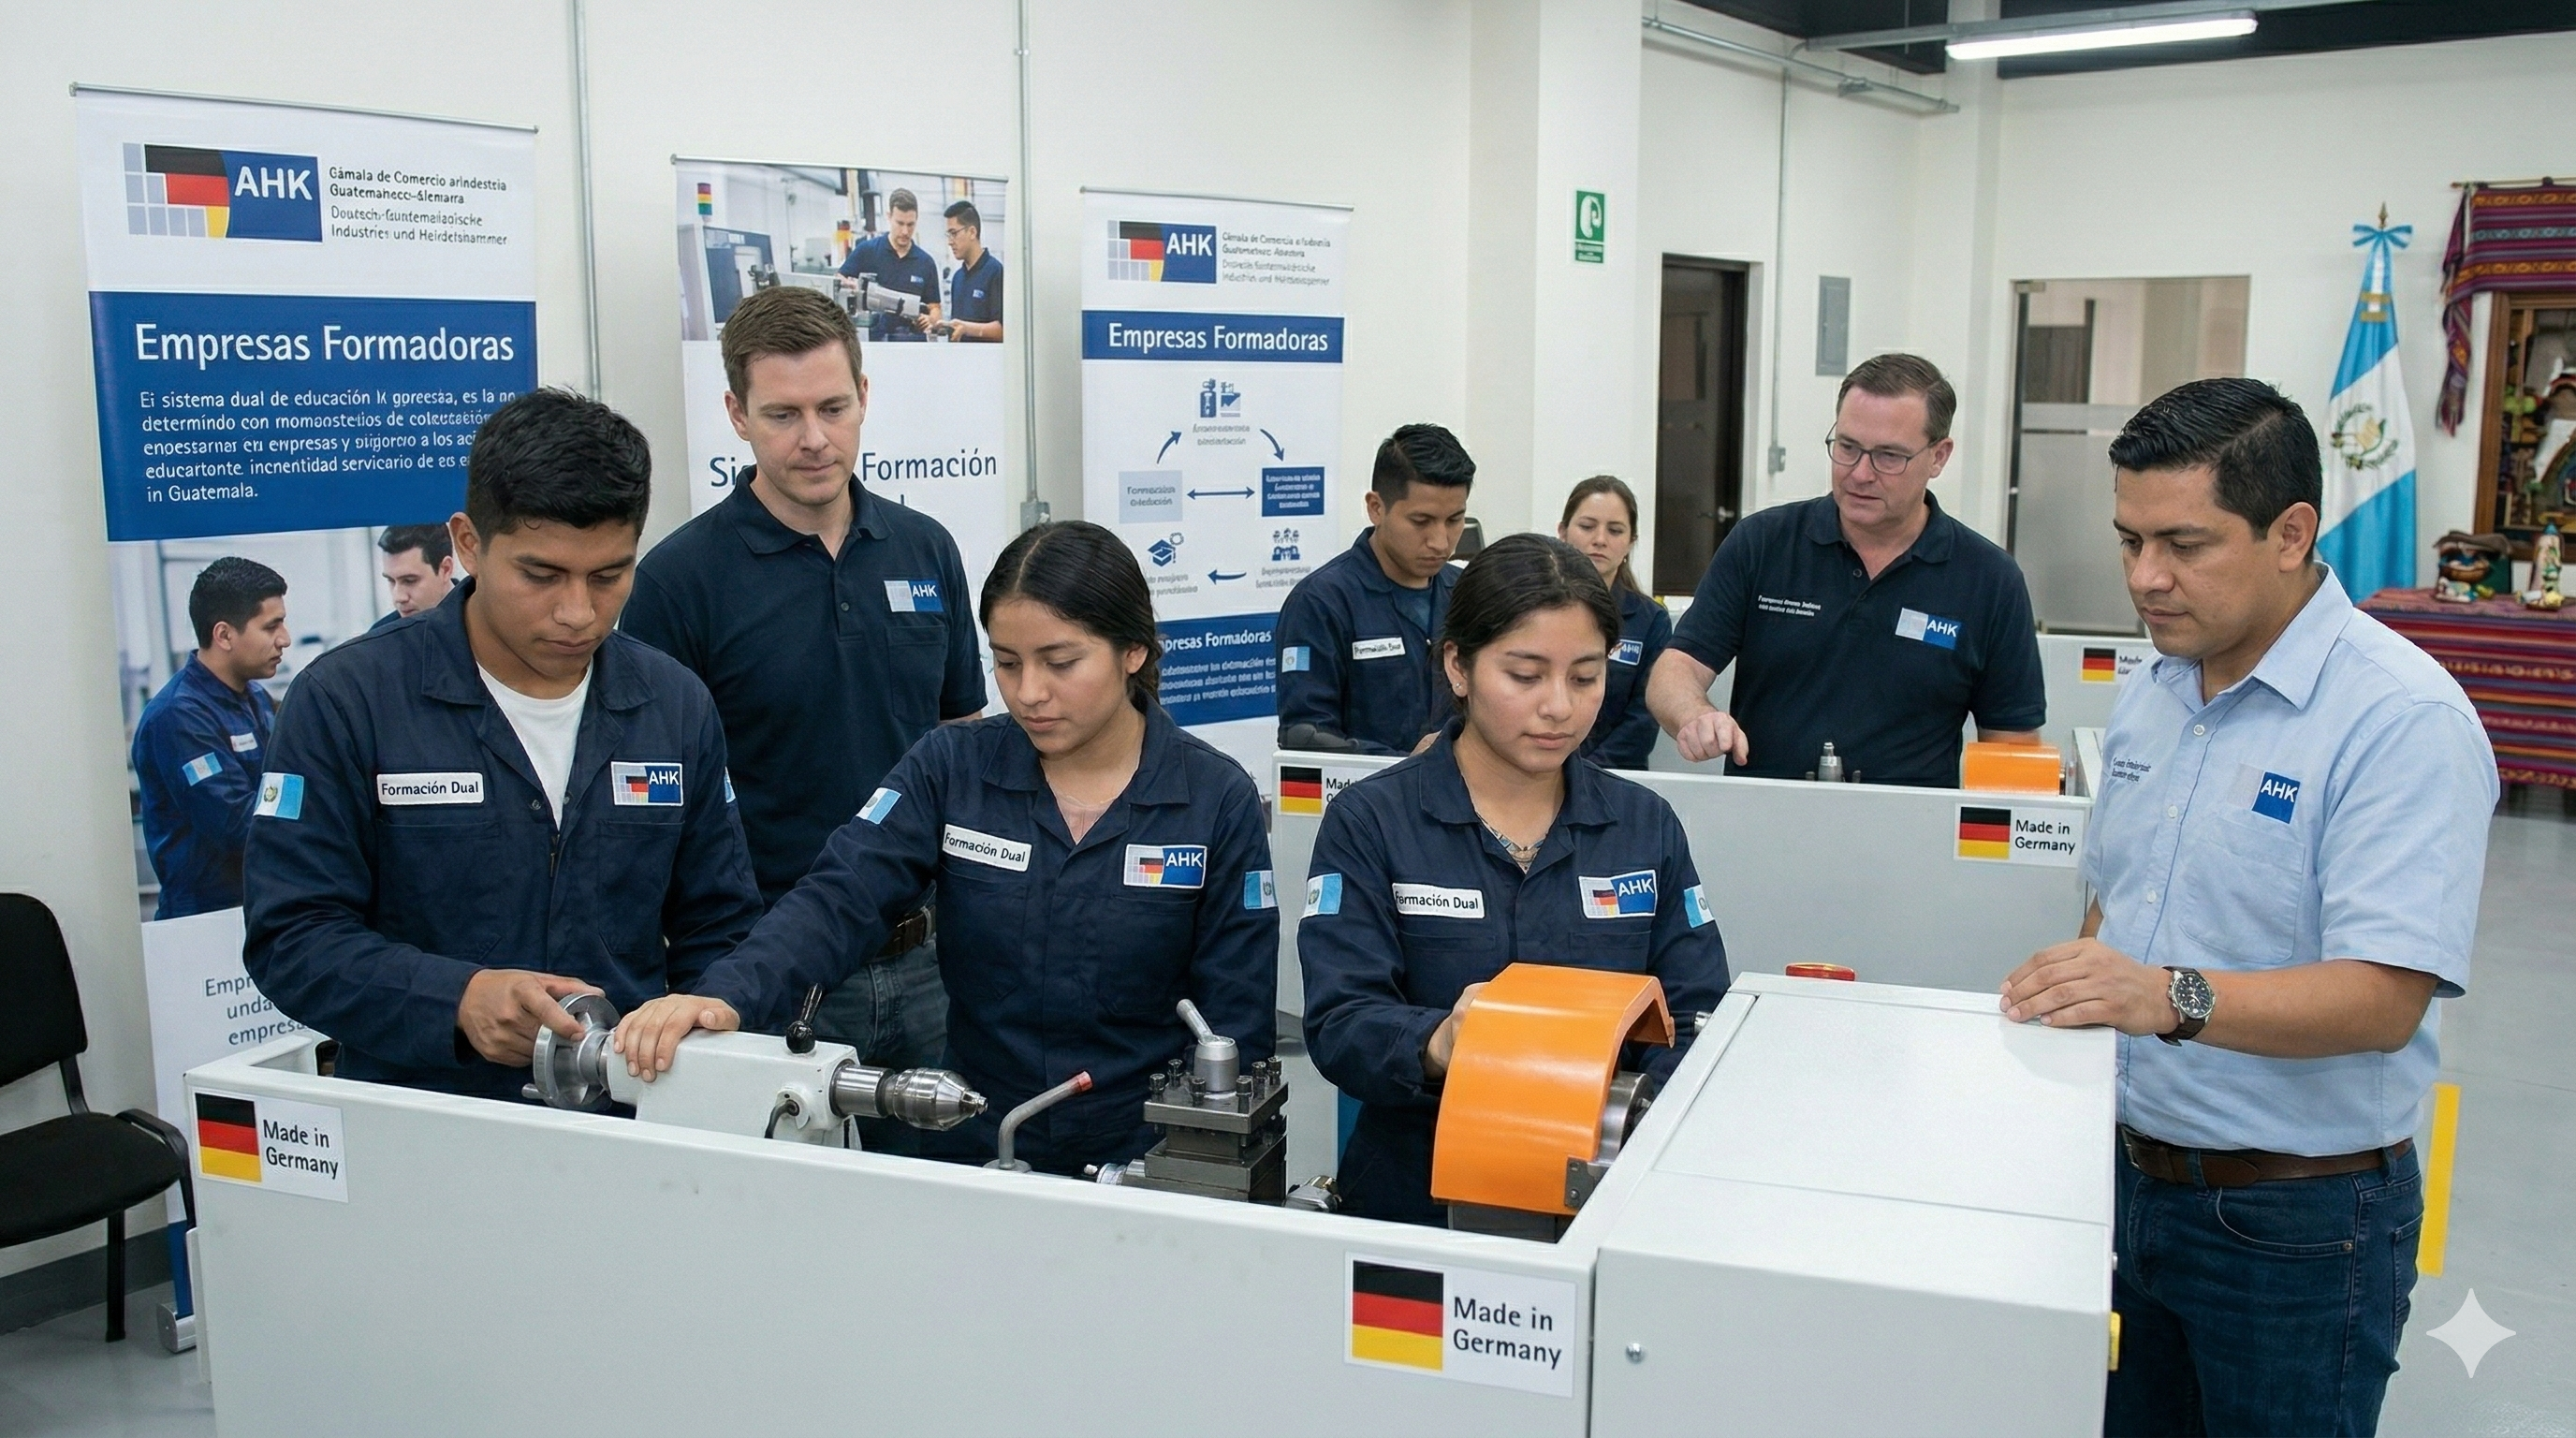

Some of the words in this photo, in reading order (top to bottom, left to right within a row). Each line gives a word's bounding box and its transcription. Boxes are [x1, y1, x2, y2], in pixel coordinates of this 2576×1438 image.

[234, 165, 313, 201] AHK
[376, 169, 391, 183] de
[393, 170, 446, 187] Comercio
[393, 227, 416, 241] und
[1166, 233, 1213, 257] AHK
[136, 323, 310, 370] Empresas
[324, 325, 514, 362] Formadoras
[1108, 322, 1207, 354] Empresas
[1214, 326, 1328, 352] Formadoras
[162, 390, 225, 408] sistema
[230, 390, 265, 407] dual
[271, 389, 289, 406] de
[294, 389, 371, 406] educación
[241, 416, 270, 430] con
[387, 411, 404, 427] de
[341, 437, 350, 453] y
[420, 434, 430, 447] a
[432, 431, 453, 447] los
[342, 454, 413, 471] servicario
[417, 453, 433, 468] de
[861, 448, 998, 482] Formación
[147, 486, 163, 503] in
[168, 482, 258, 502] Guatemala.
[912, 584, 937, 597] AHK
[1206, 629, 1272, 647] Formadoras
[1926, 619, 1958, 638] AHK
[649, 770, 680, 785] AHK
[381, 780, 446, 796] Formación
[451, 780, 479, 794] Dual
[2260, 778, 2299, 803] AHK
[2015, 819, 2053, 834] Made
[2058, 822, 2071, 834] in
[944, 833, 998, 857] Formación
[1001, 846, 1026, 862] Dual
[2015, 836, 2075, 856] Germany
[1165, 852, 1204, 868] AHK
[1617, 877, 1654, 897] AHK
[1395, 891, 1450, 909] Formación
[1453, 895, 1479, 910] Dual
[263, 1119, 309, 1145] Made
[314, 1127, 329, 1148] in
[266, 1146, 339, 1180] Germany
[1454, 1297, 1521, 1327] Made
[1531, 1307, 1553, 1331] in
[1453, 1328, 1562, 1371] Germany
